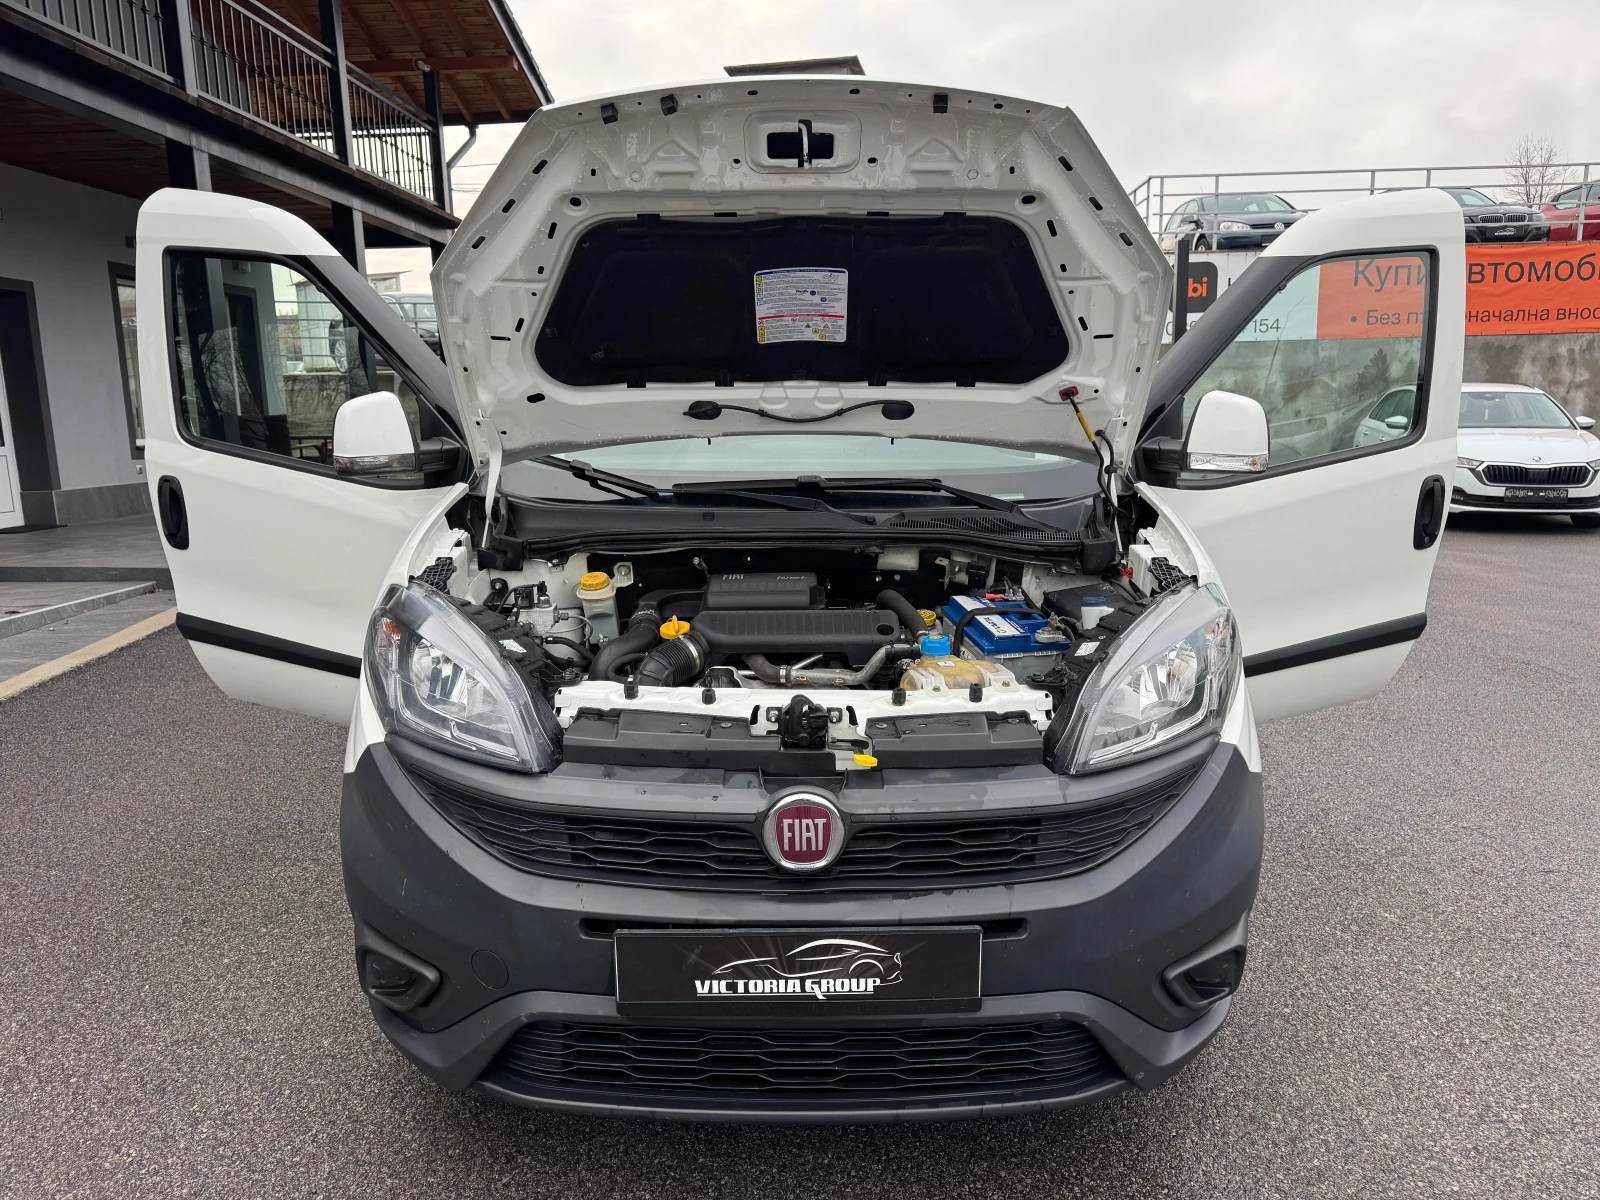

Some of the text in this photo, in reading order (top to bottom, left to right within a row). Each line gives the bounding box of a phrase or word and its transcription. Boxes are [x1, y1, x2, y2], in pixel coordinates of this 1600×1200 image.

[1467, 253, 1600, 284] втомоб
[1187, 277, 1208, 297] bi
[1252, 318, 1281, 334] 154
[1366, 310, 1402, 326] Без
[783, 818, 826, 851] FIAT
[695, 978, 881, 999] VICTORIA GROUP
